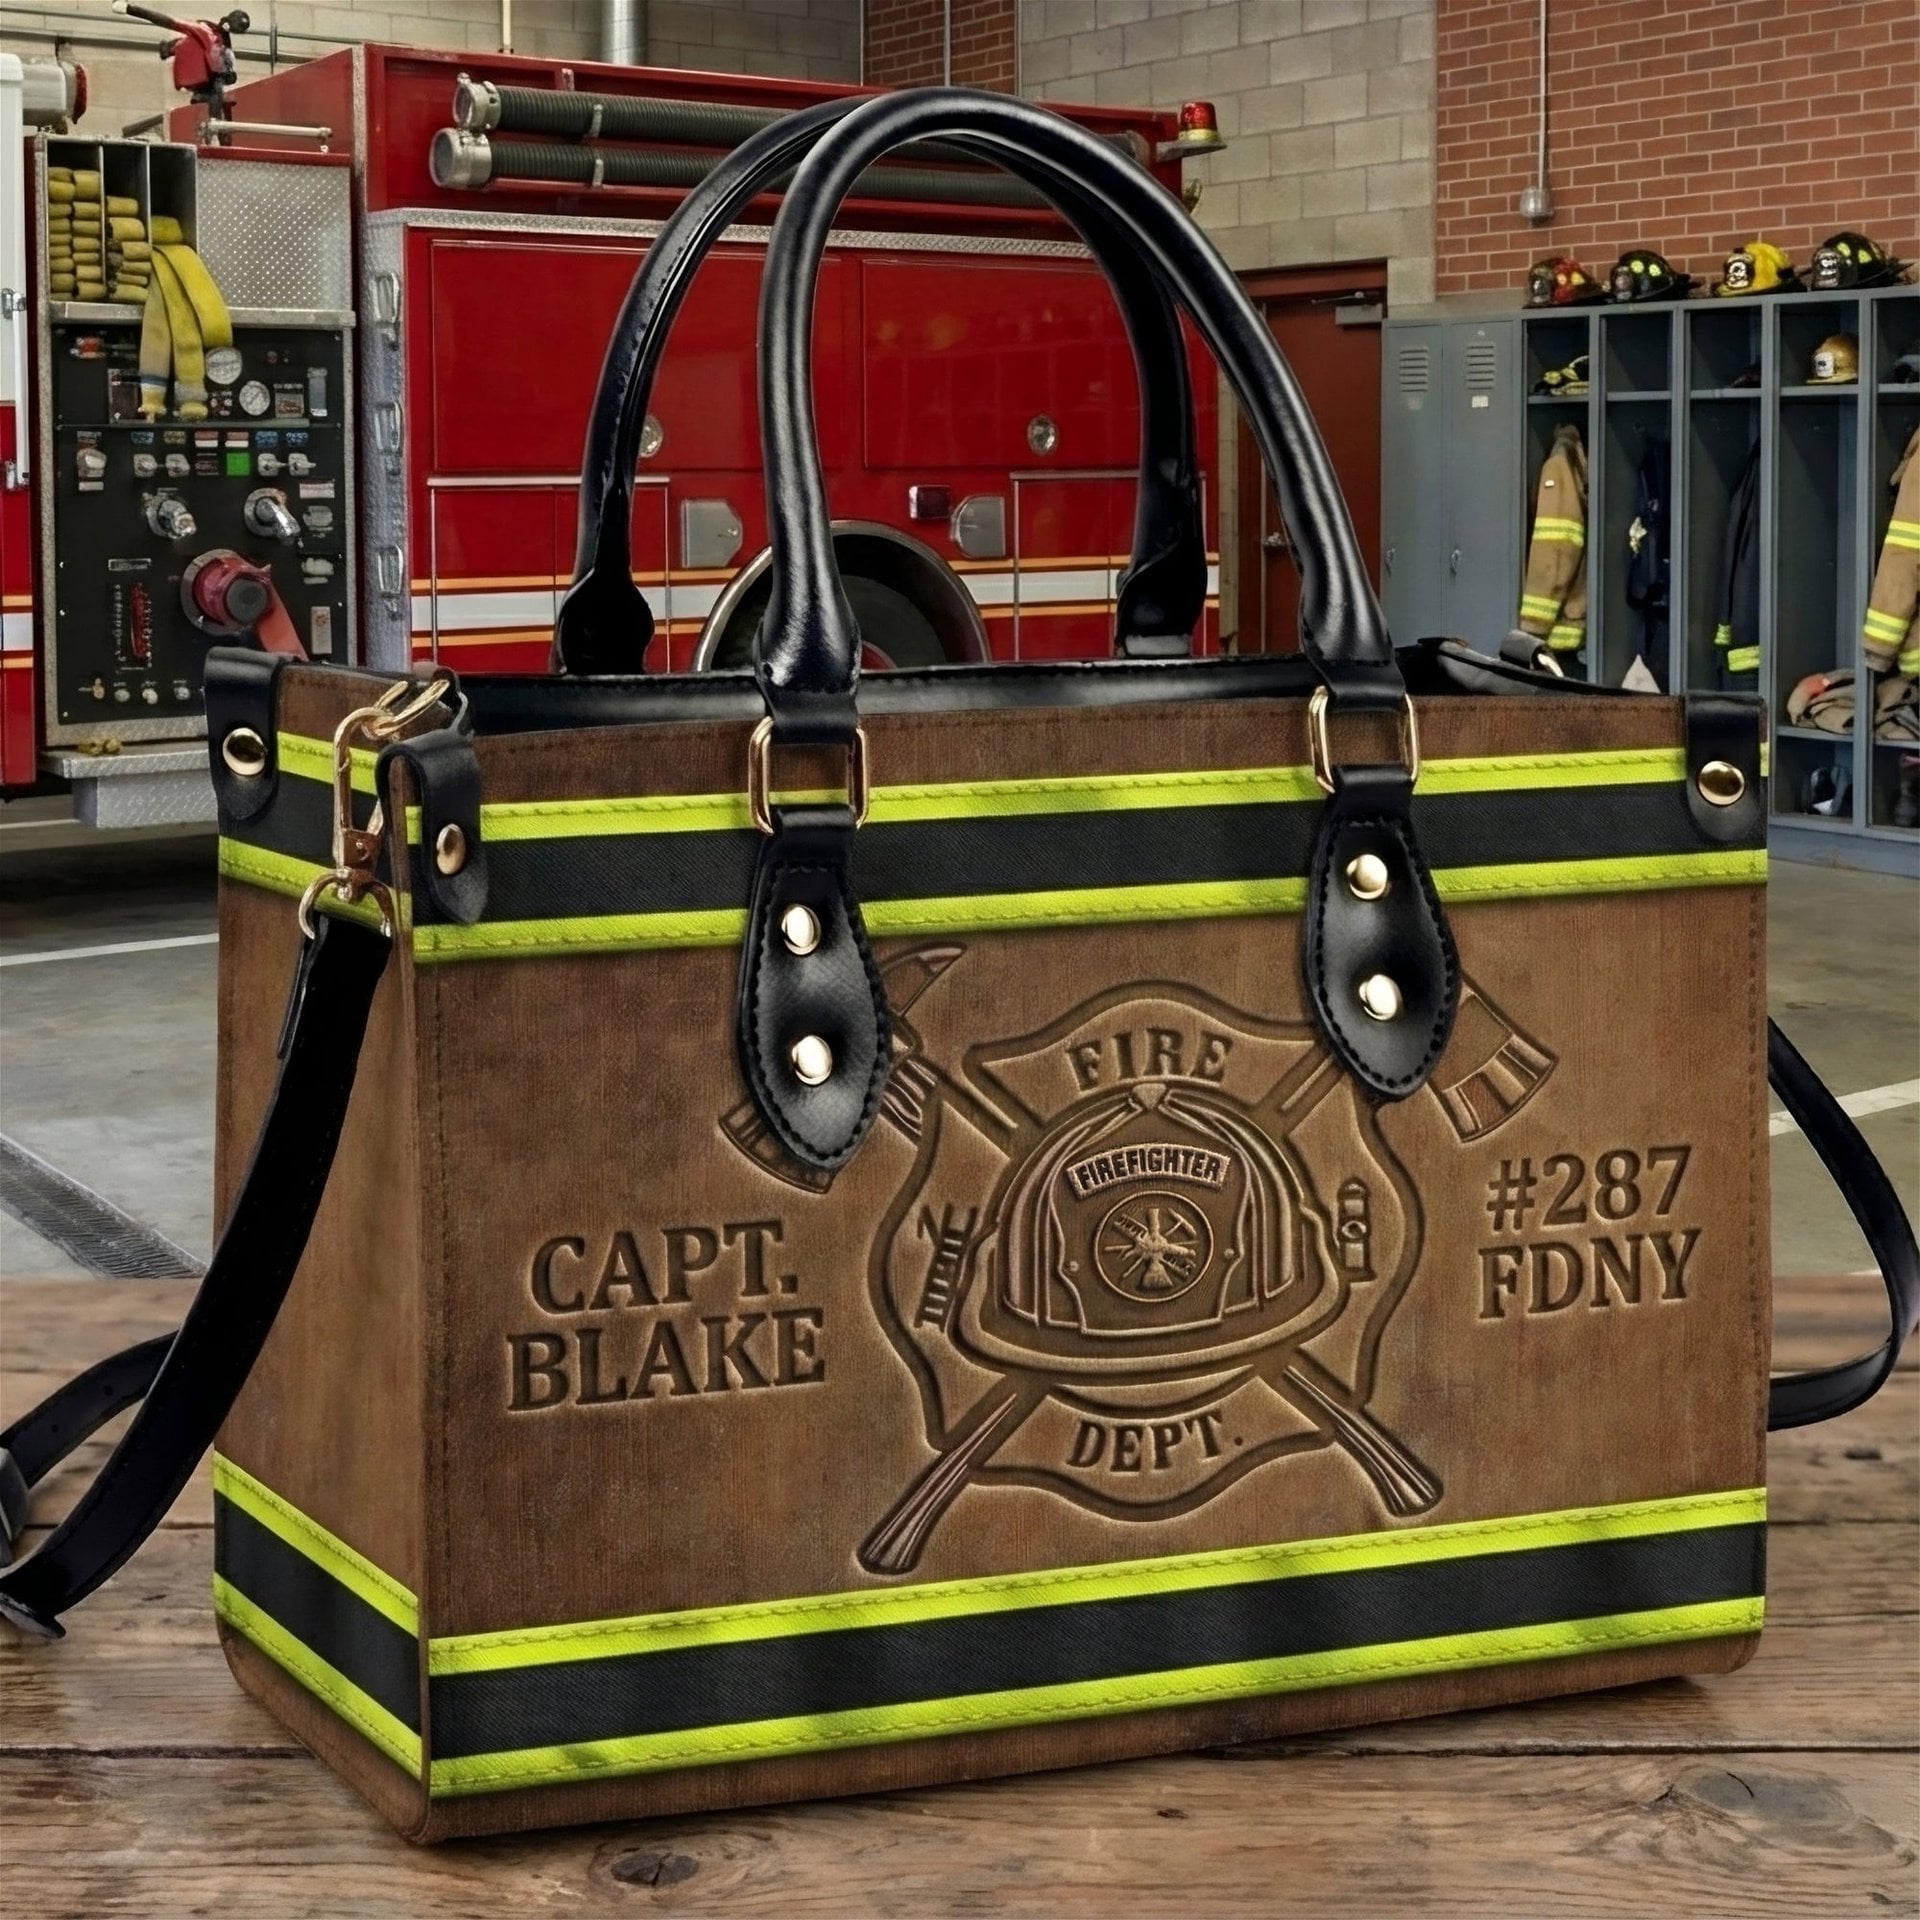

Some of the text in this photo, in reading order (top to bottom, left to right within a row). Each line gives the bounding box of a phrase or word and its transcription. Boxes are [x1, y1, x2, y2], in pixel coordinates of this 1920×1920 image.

[1066, 1027, 1233, 1092] FIRE
[1074, 1146, 1222, 1191] FIREFIGHTER
[1486, 1145, 1692, 1231] #287
[531, 1218, 799, 1315] CAPT.
[1478, 1226, 1701, 1319] FDNY
[507, 1308, 826, 1412] BLAKE
[1066, 1408, 1243, 1473] DEPT.
